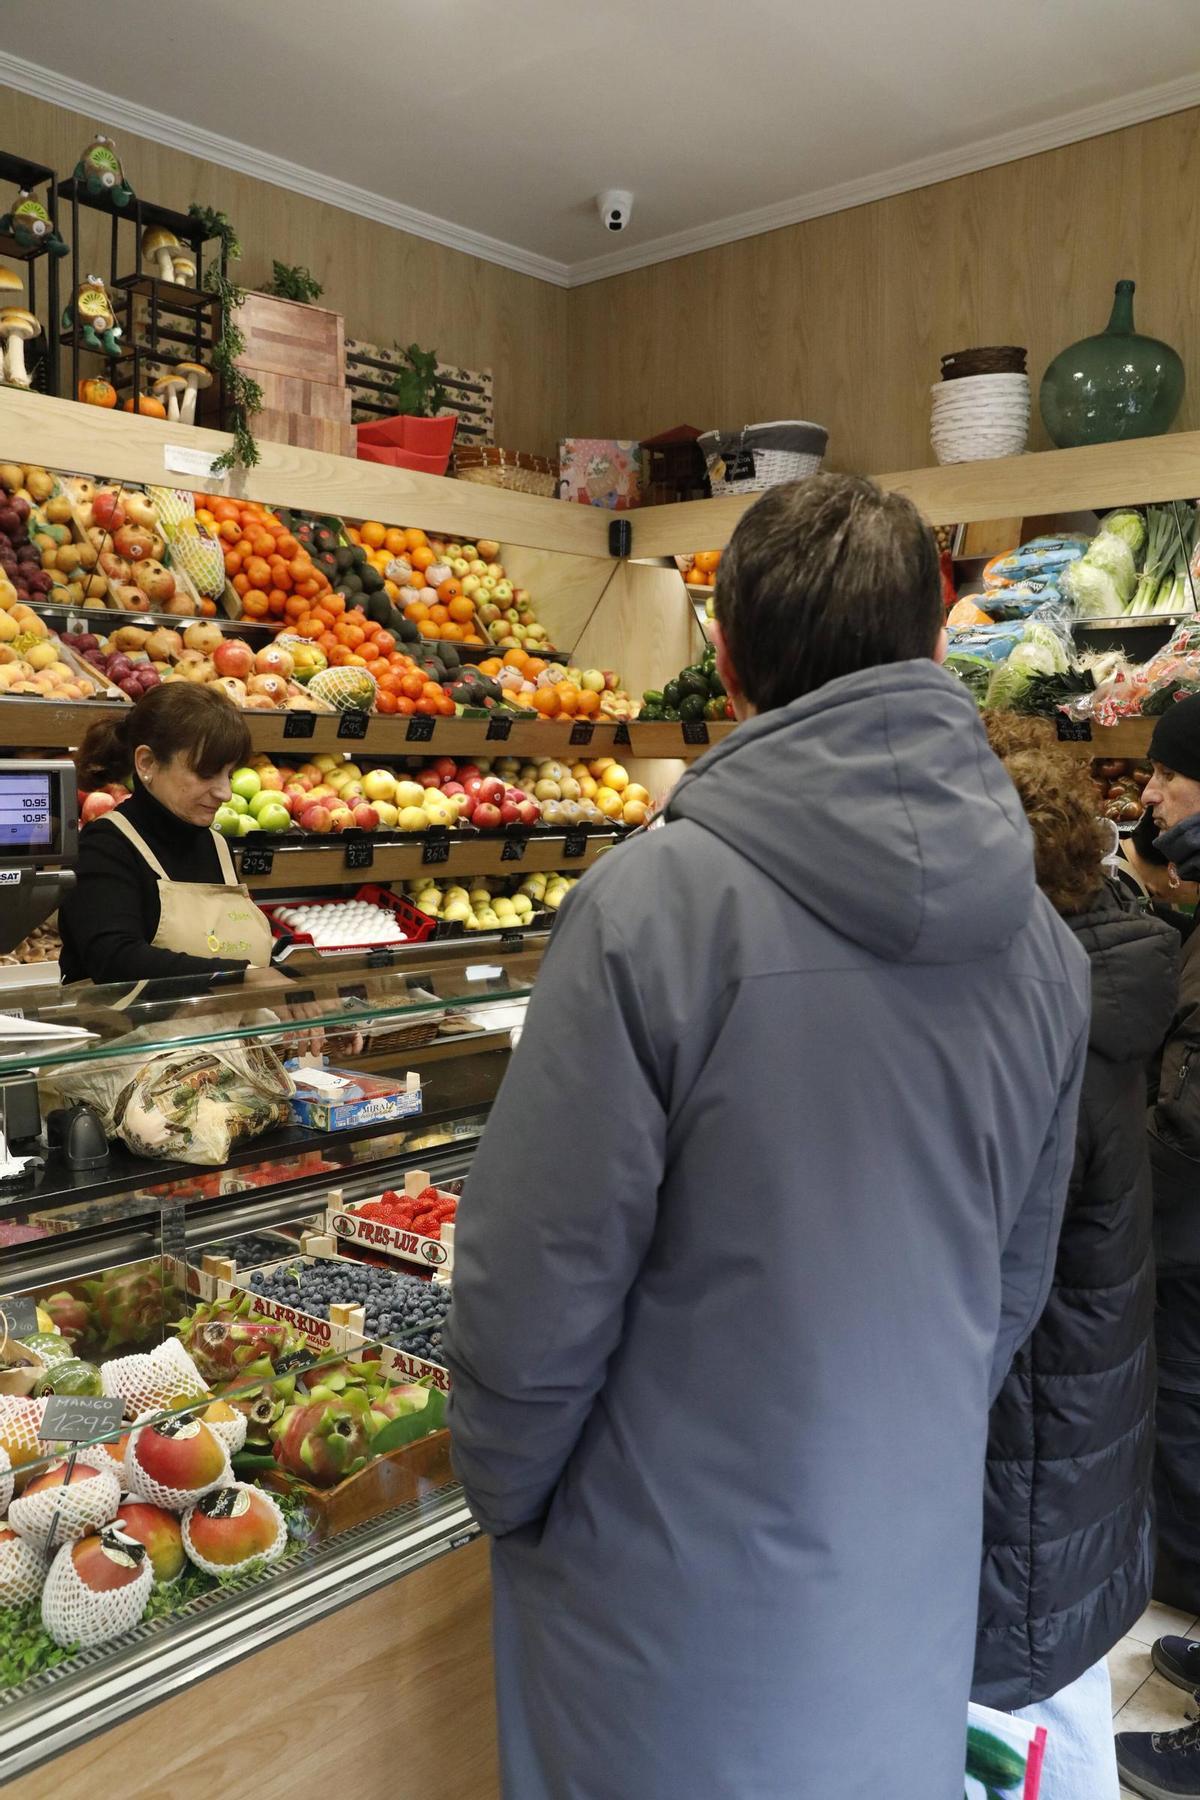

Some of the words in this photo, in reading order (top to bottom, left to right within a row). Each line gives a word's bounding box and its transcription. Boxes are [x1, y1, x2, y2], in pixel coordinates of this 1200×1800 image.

[357, 1220, 420, 1255] FRES-LUZ
[253, 1297, 332, 1342] ALFREDO
[299, 1331, 331, 1348] GNZALEZ
[391, 1352, 450, 1391] ALFR
[55, 1398, 113, 1410] MANGO
